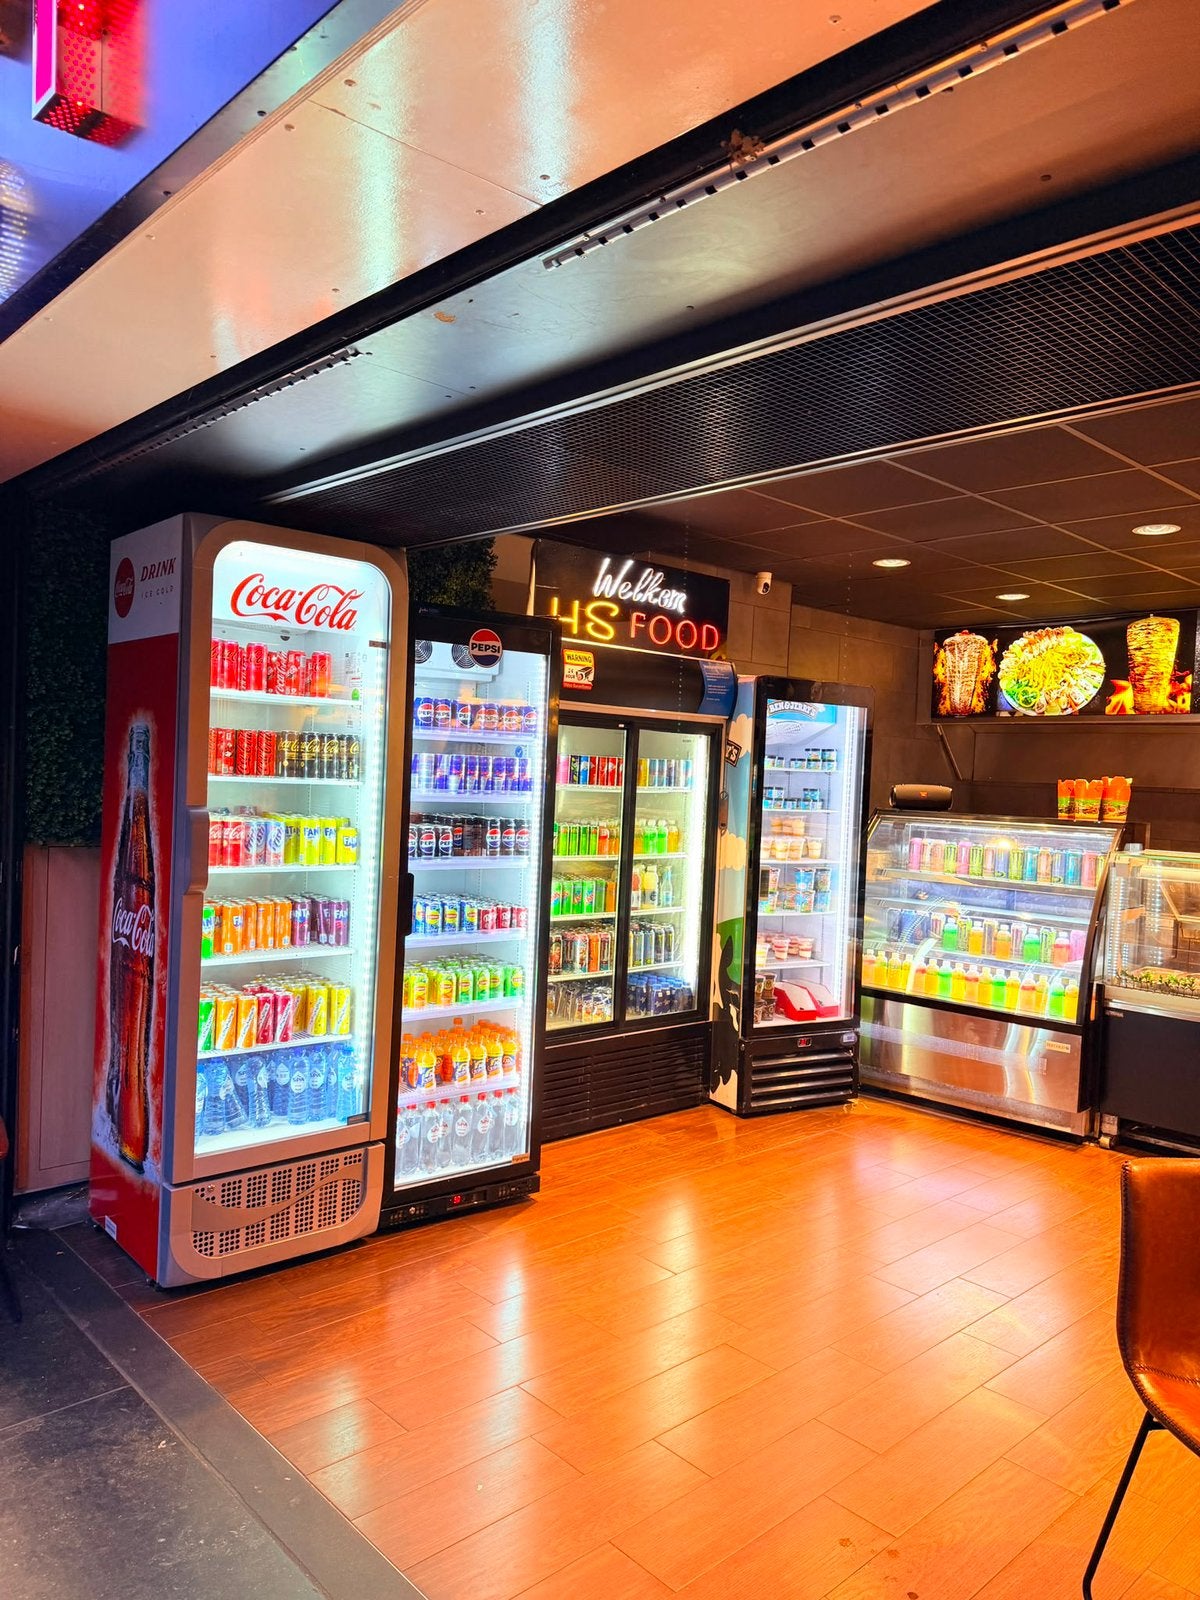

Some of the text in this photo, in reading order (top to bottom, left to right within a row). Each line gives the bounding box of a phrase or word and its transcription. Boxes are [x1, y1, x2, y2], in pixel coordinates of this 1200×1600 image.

[140, 558, 177, 582] DRINK
[592, 557, 688, 615] Welkom
[141, 585, 174, 599] ICE COLD
[230, 573, 366, 631] Coca-Cola
[551, 596, 719, 650] HS FOOD
[471, 643, 501, 654] PEPSI
[566, 653, 592, 664] WARNING
[112, 897, 155, 958] Coca-Cola
